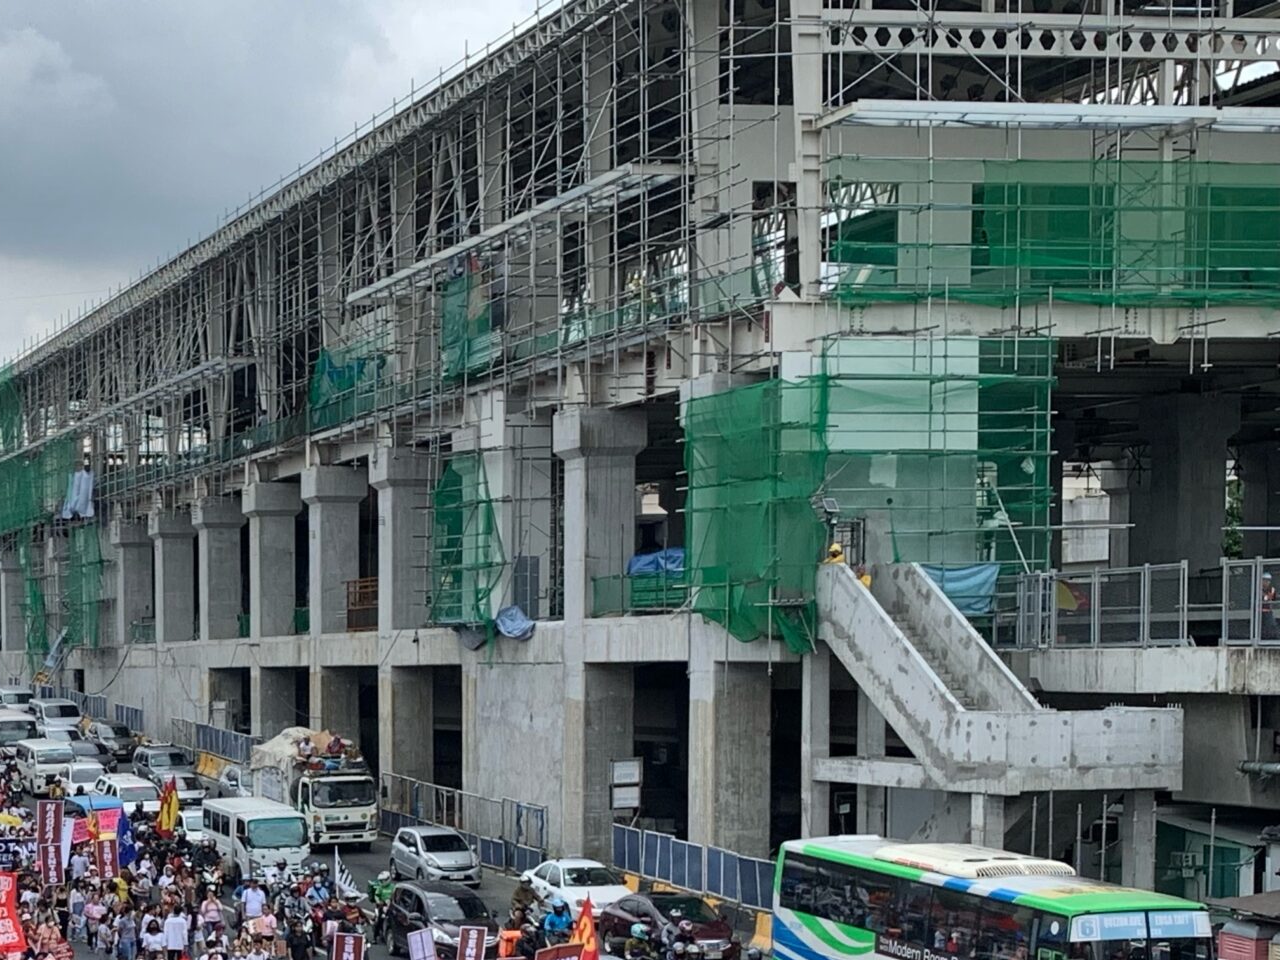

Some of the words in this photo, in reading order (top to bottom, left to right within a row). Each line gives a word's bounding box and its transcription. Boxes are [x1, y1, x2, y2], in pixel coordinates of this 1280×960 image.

[48, 845, 59, 884] SENTRO
[104, 841, 114, 878] SENTRO
[889, 942, 921, 960] Modern
